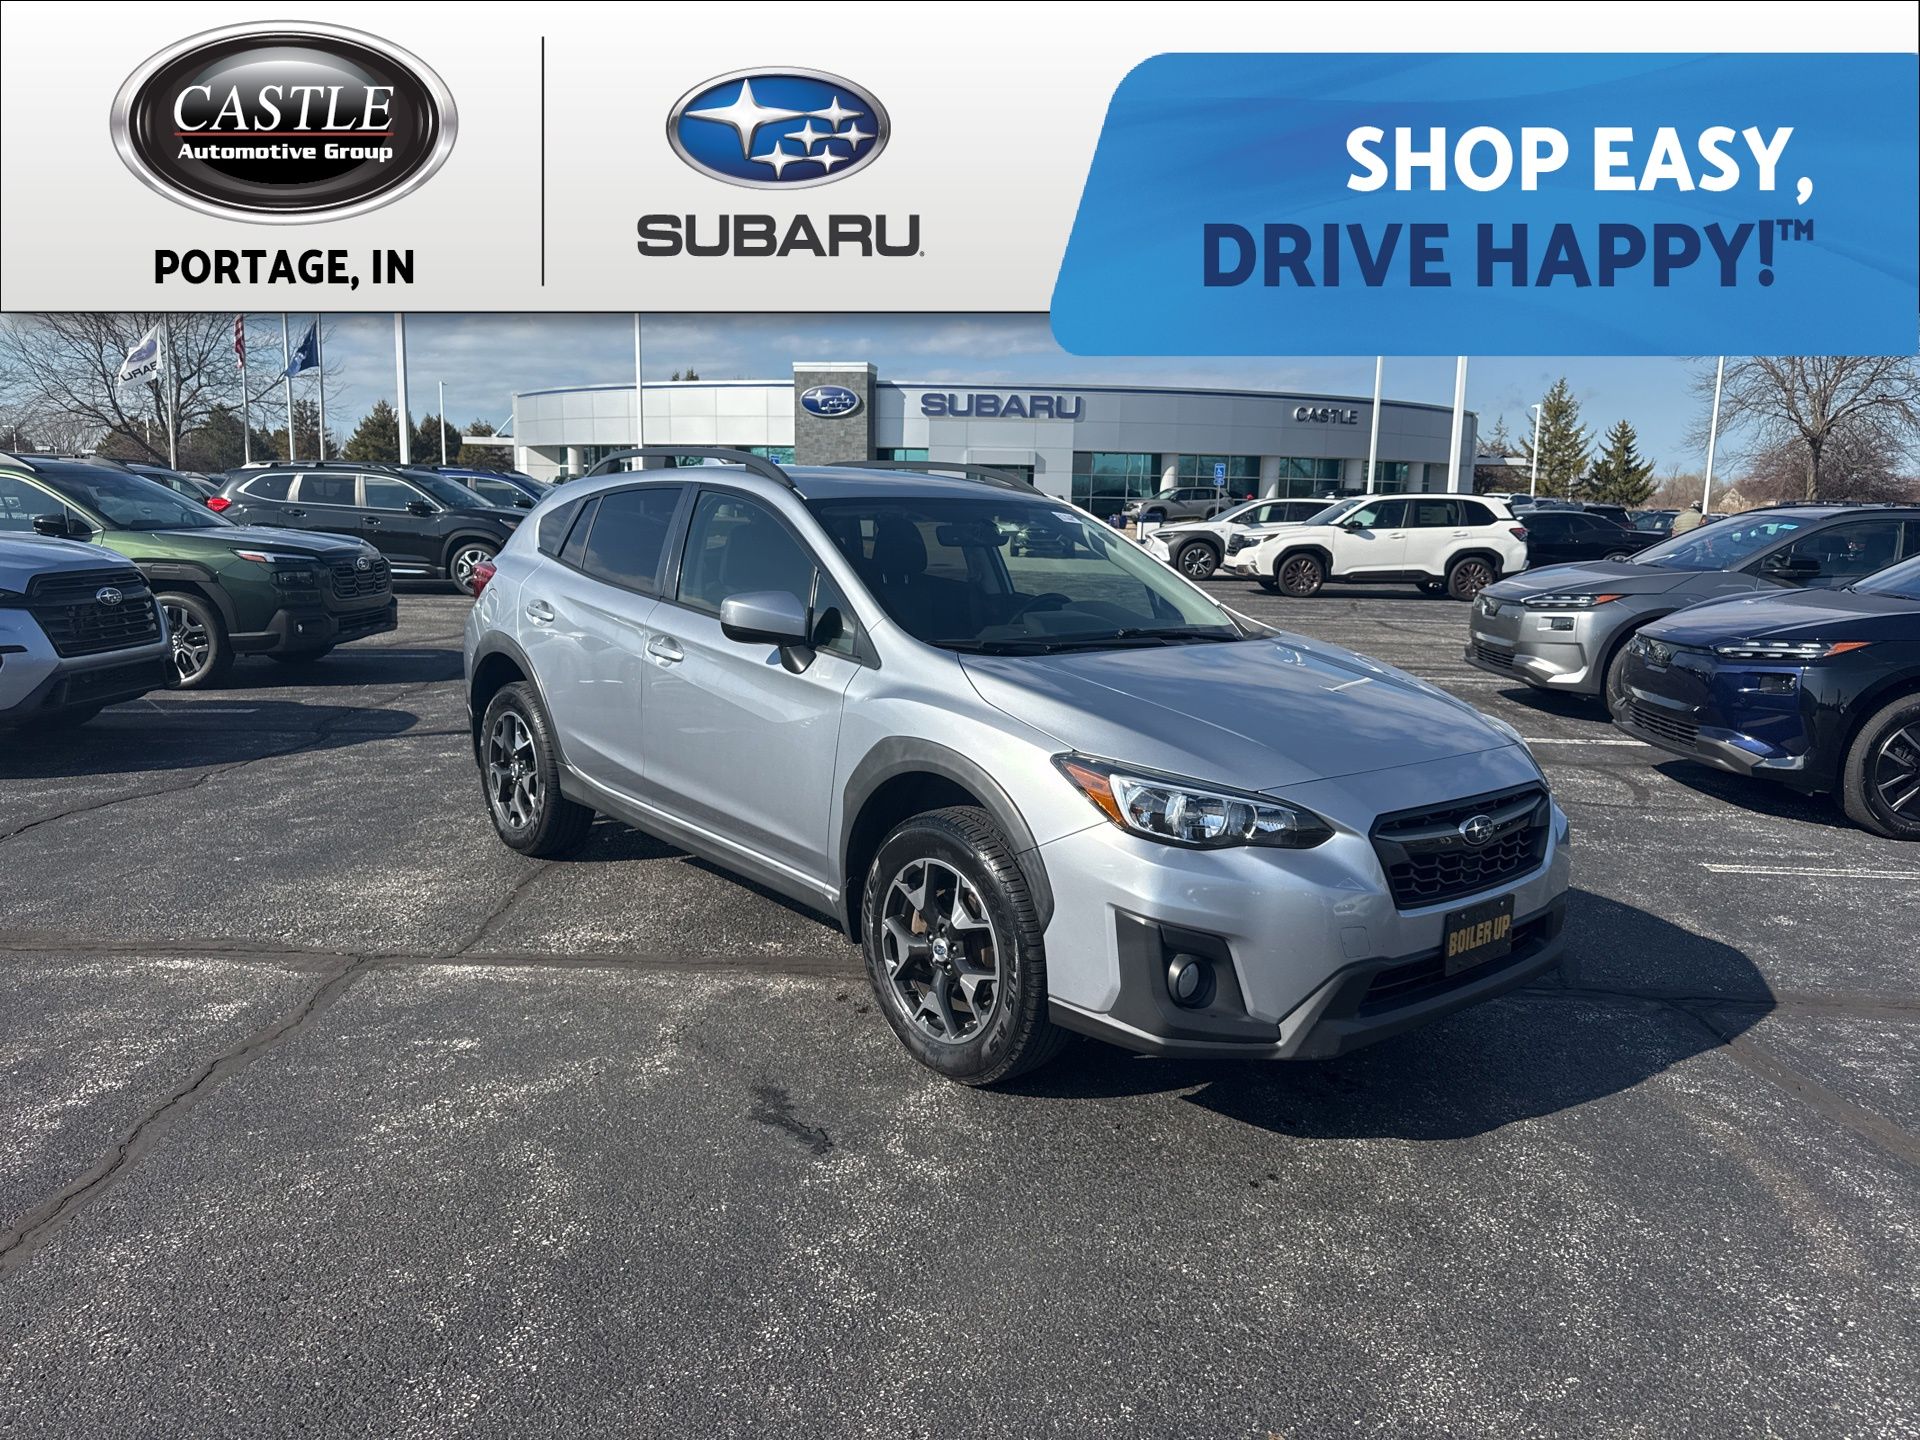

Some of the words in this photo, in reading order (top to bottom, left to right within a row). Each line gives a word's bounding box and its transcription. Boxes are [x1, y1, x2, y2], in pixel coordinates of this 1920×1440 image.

[921, 393, 1081, 419] SUBARU
[1296, 407, 1358, 425] CASTLE
[1448, 920, 1493, 957] BOILER
[1493, 914, 1511, 940] UP
